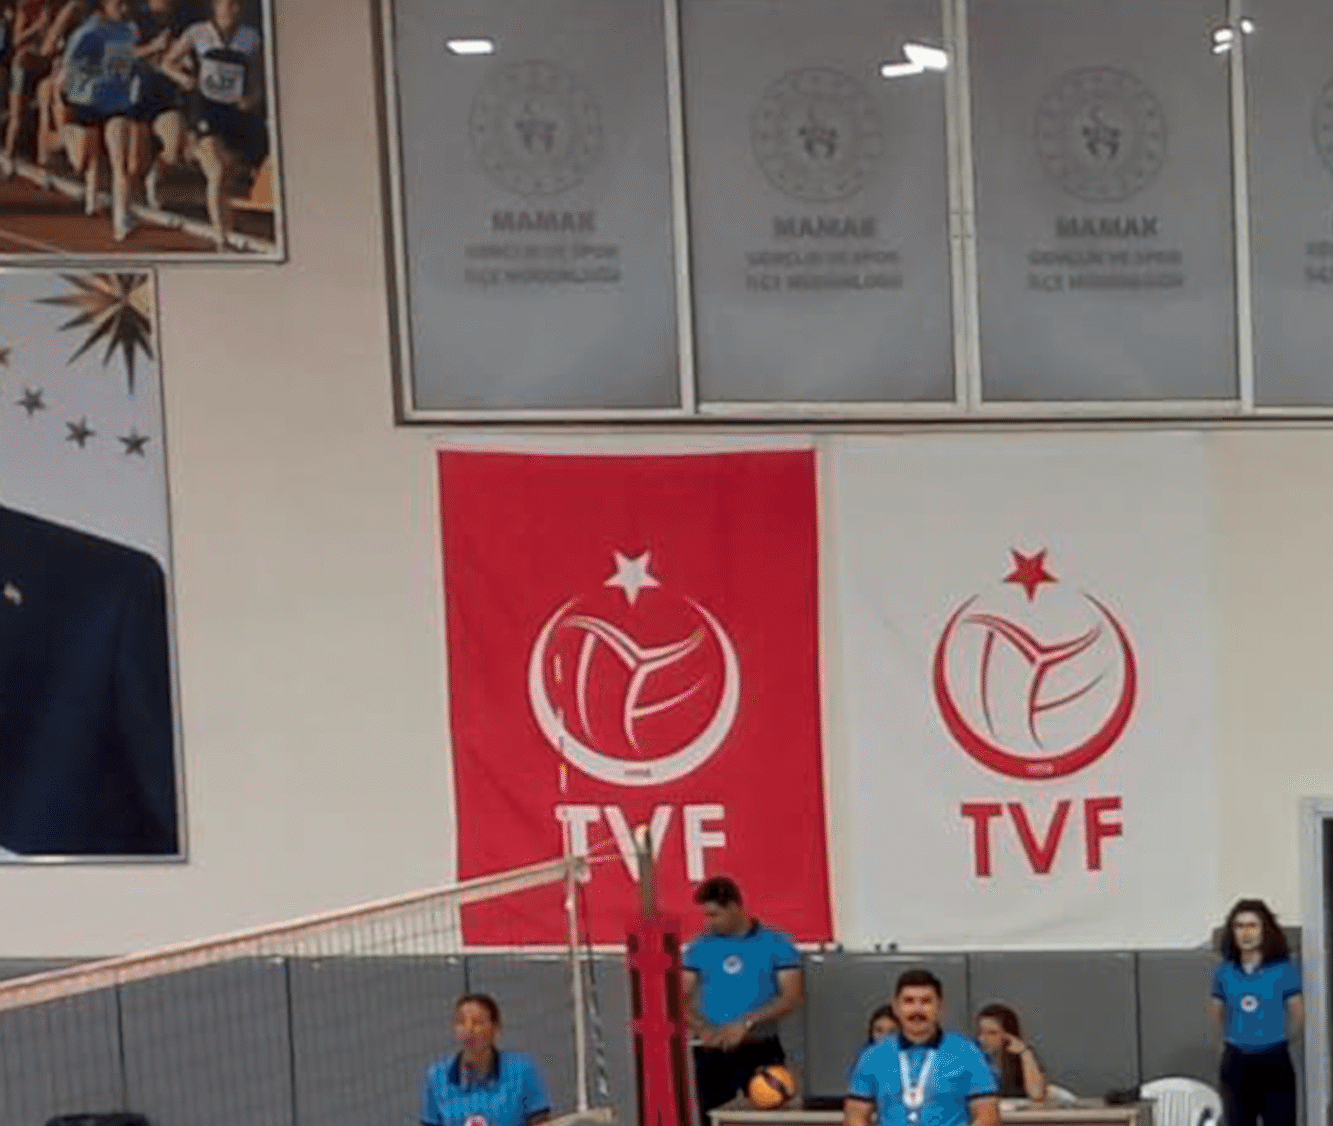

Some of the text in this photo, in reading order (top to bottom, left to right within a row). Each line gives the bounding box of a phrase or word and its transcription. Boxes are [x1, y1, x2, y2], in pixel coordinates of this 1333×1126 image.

[491, 211, 596, 232] MAMAK
[554, 804, 727, 883] TVF
[959, 795, 1125, 878] TVF
